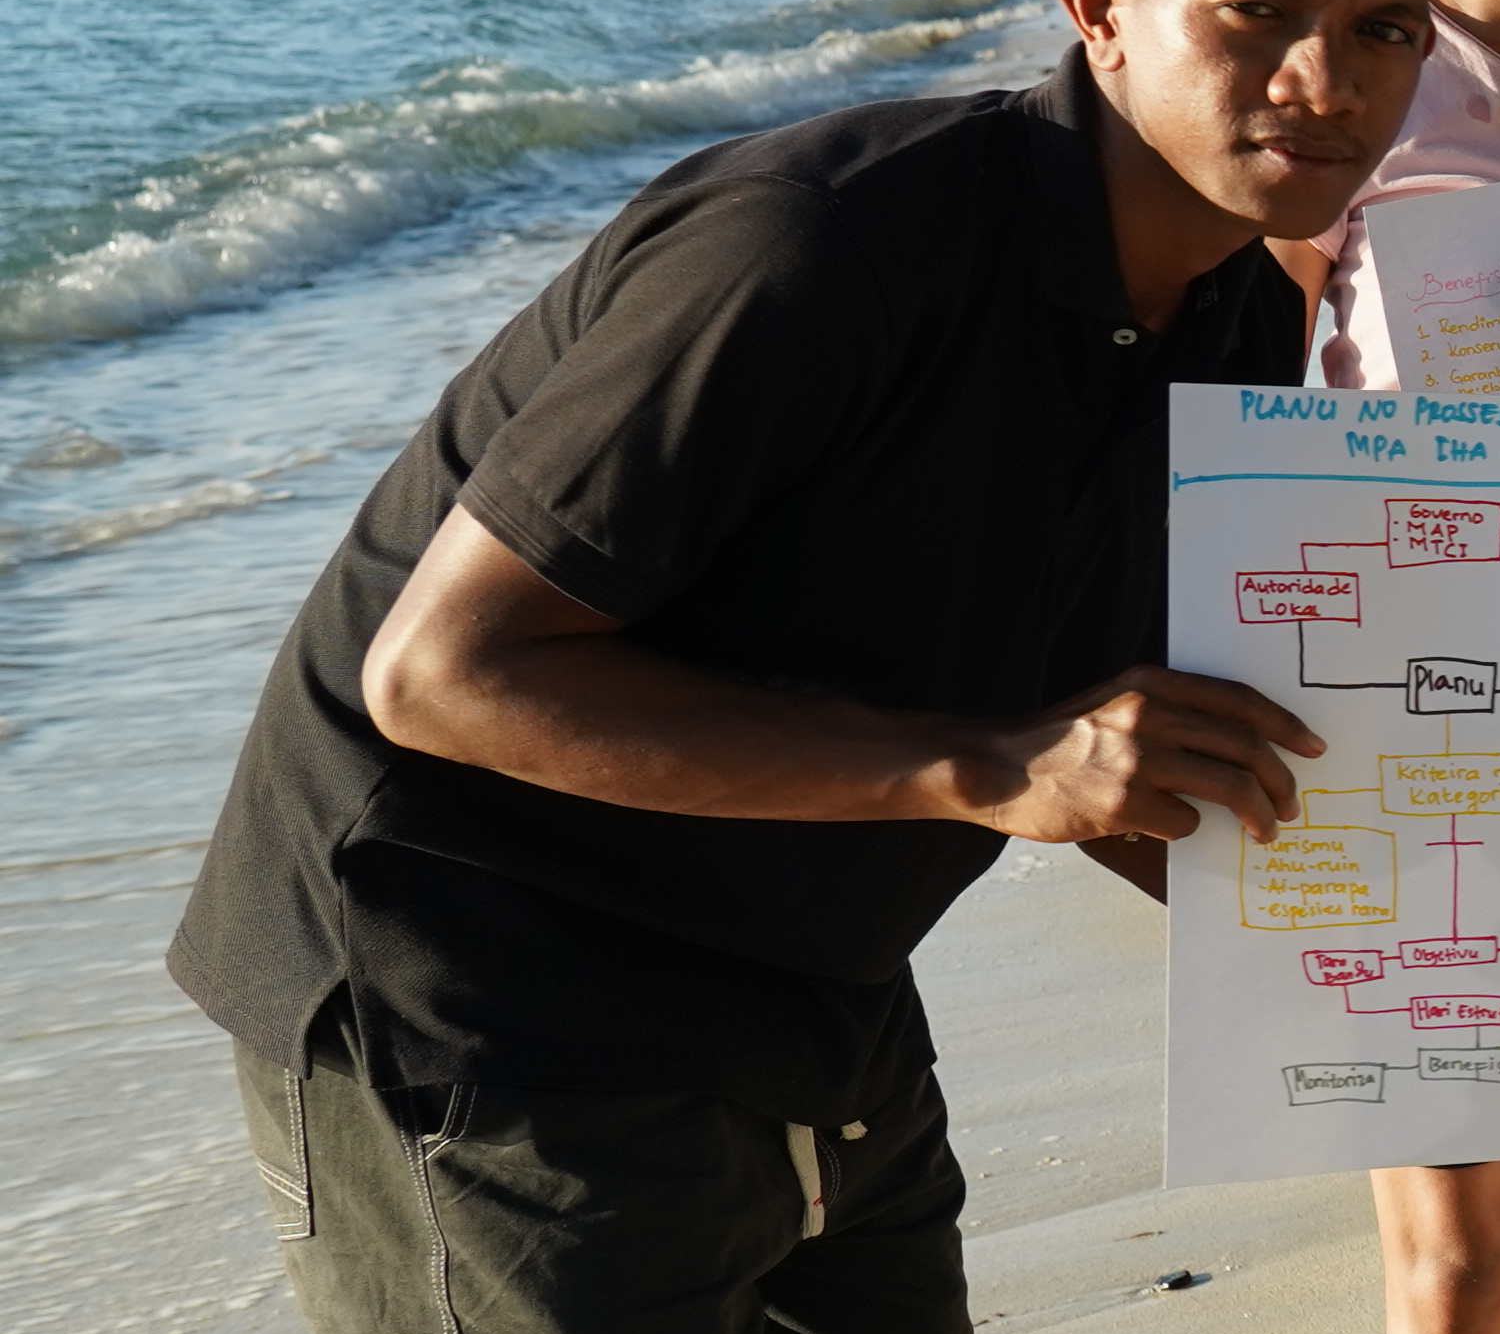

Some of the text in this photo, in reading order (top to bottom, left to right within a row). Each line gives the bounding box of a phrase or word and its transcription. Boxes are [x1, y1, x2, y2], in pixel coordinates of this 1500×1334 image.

[1241, 388, 1339, 424] PLANU
[1358, 398, 1397, 423] NO
[1346, 430, 1407, 459] MPA
[1436, 435, 1488, 465] IHA
[1410, 502, 1484, 525] Governo
[1407, 522, 1460, 539] MAP
